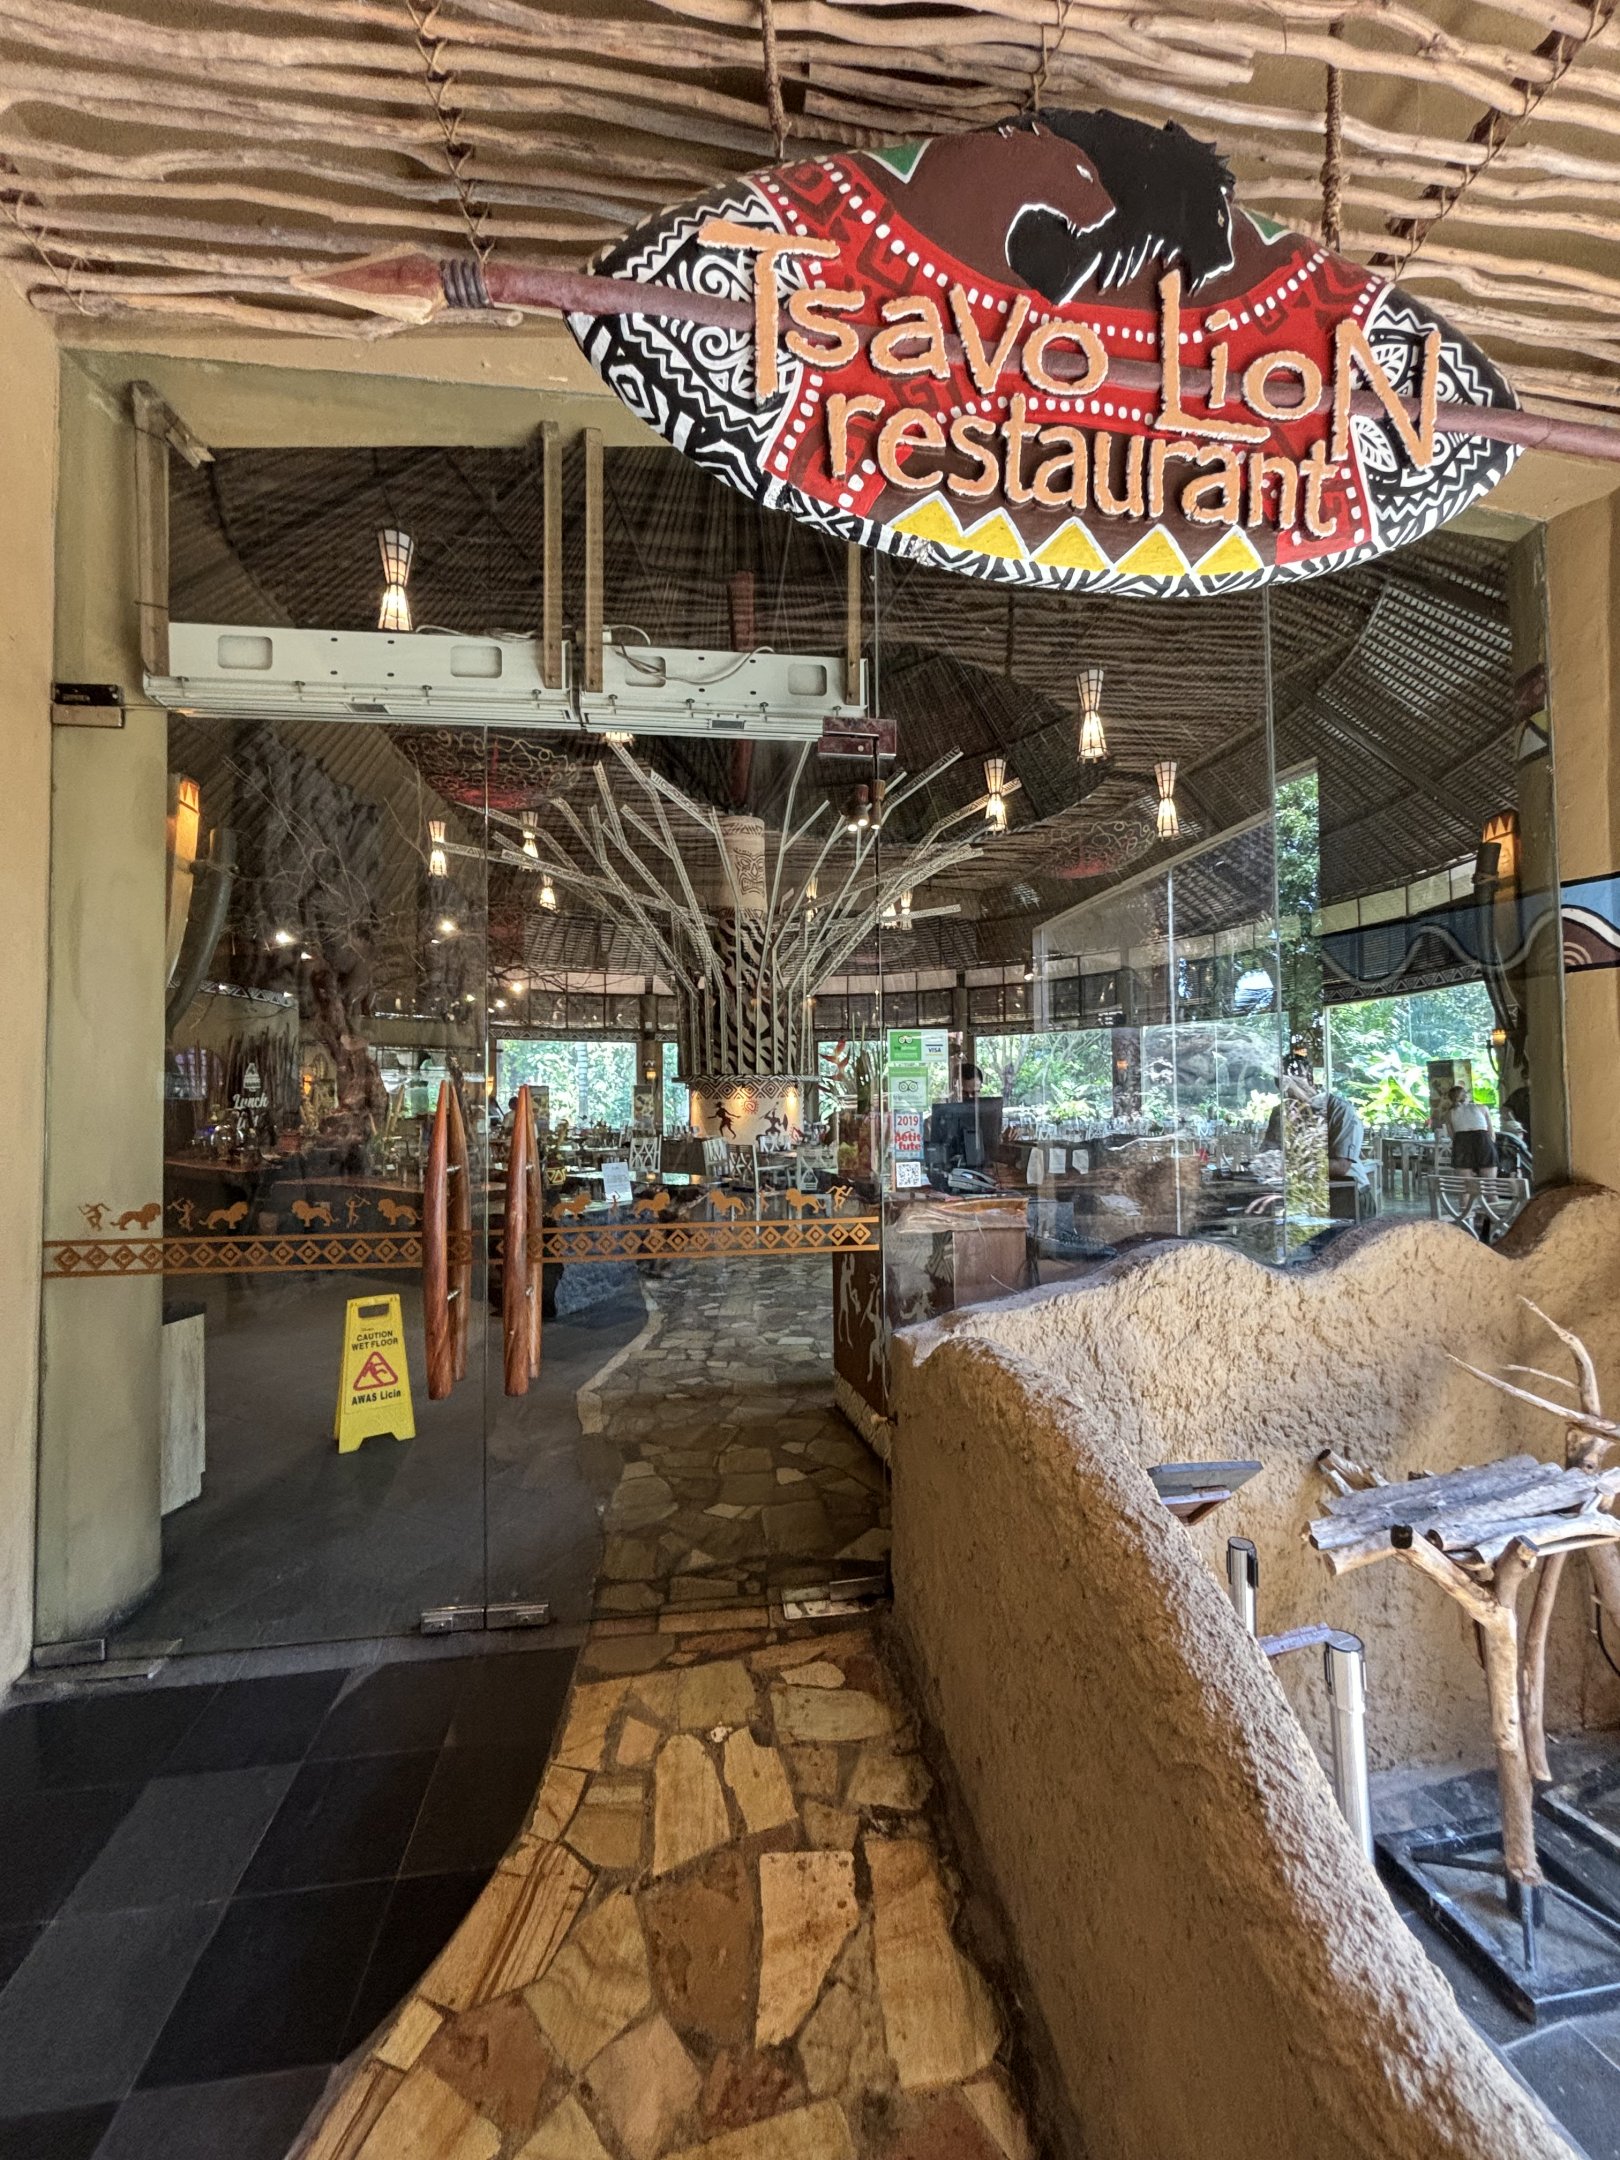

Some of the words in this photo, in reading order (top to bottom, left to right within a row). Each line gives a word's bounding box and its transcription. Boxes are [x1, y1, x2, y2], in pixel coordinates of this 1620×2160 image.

[825, 393, 1340, 539] restaurant
[232, 1092, 269, 1110] Lunch
[897, 1115, 919, 1126] 2019
[356, 1330, 393, 1342] CAUTION
[351, 1341, 370, 1351] WET
[370, 1337, 398, 1348] FLOOR
[351, 1392, 377, 1406] AWAS
[380, 1389, 401, 1401] Licin
